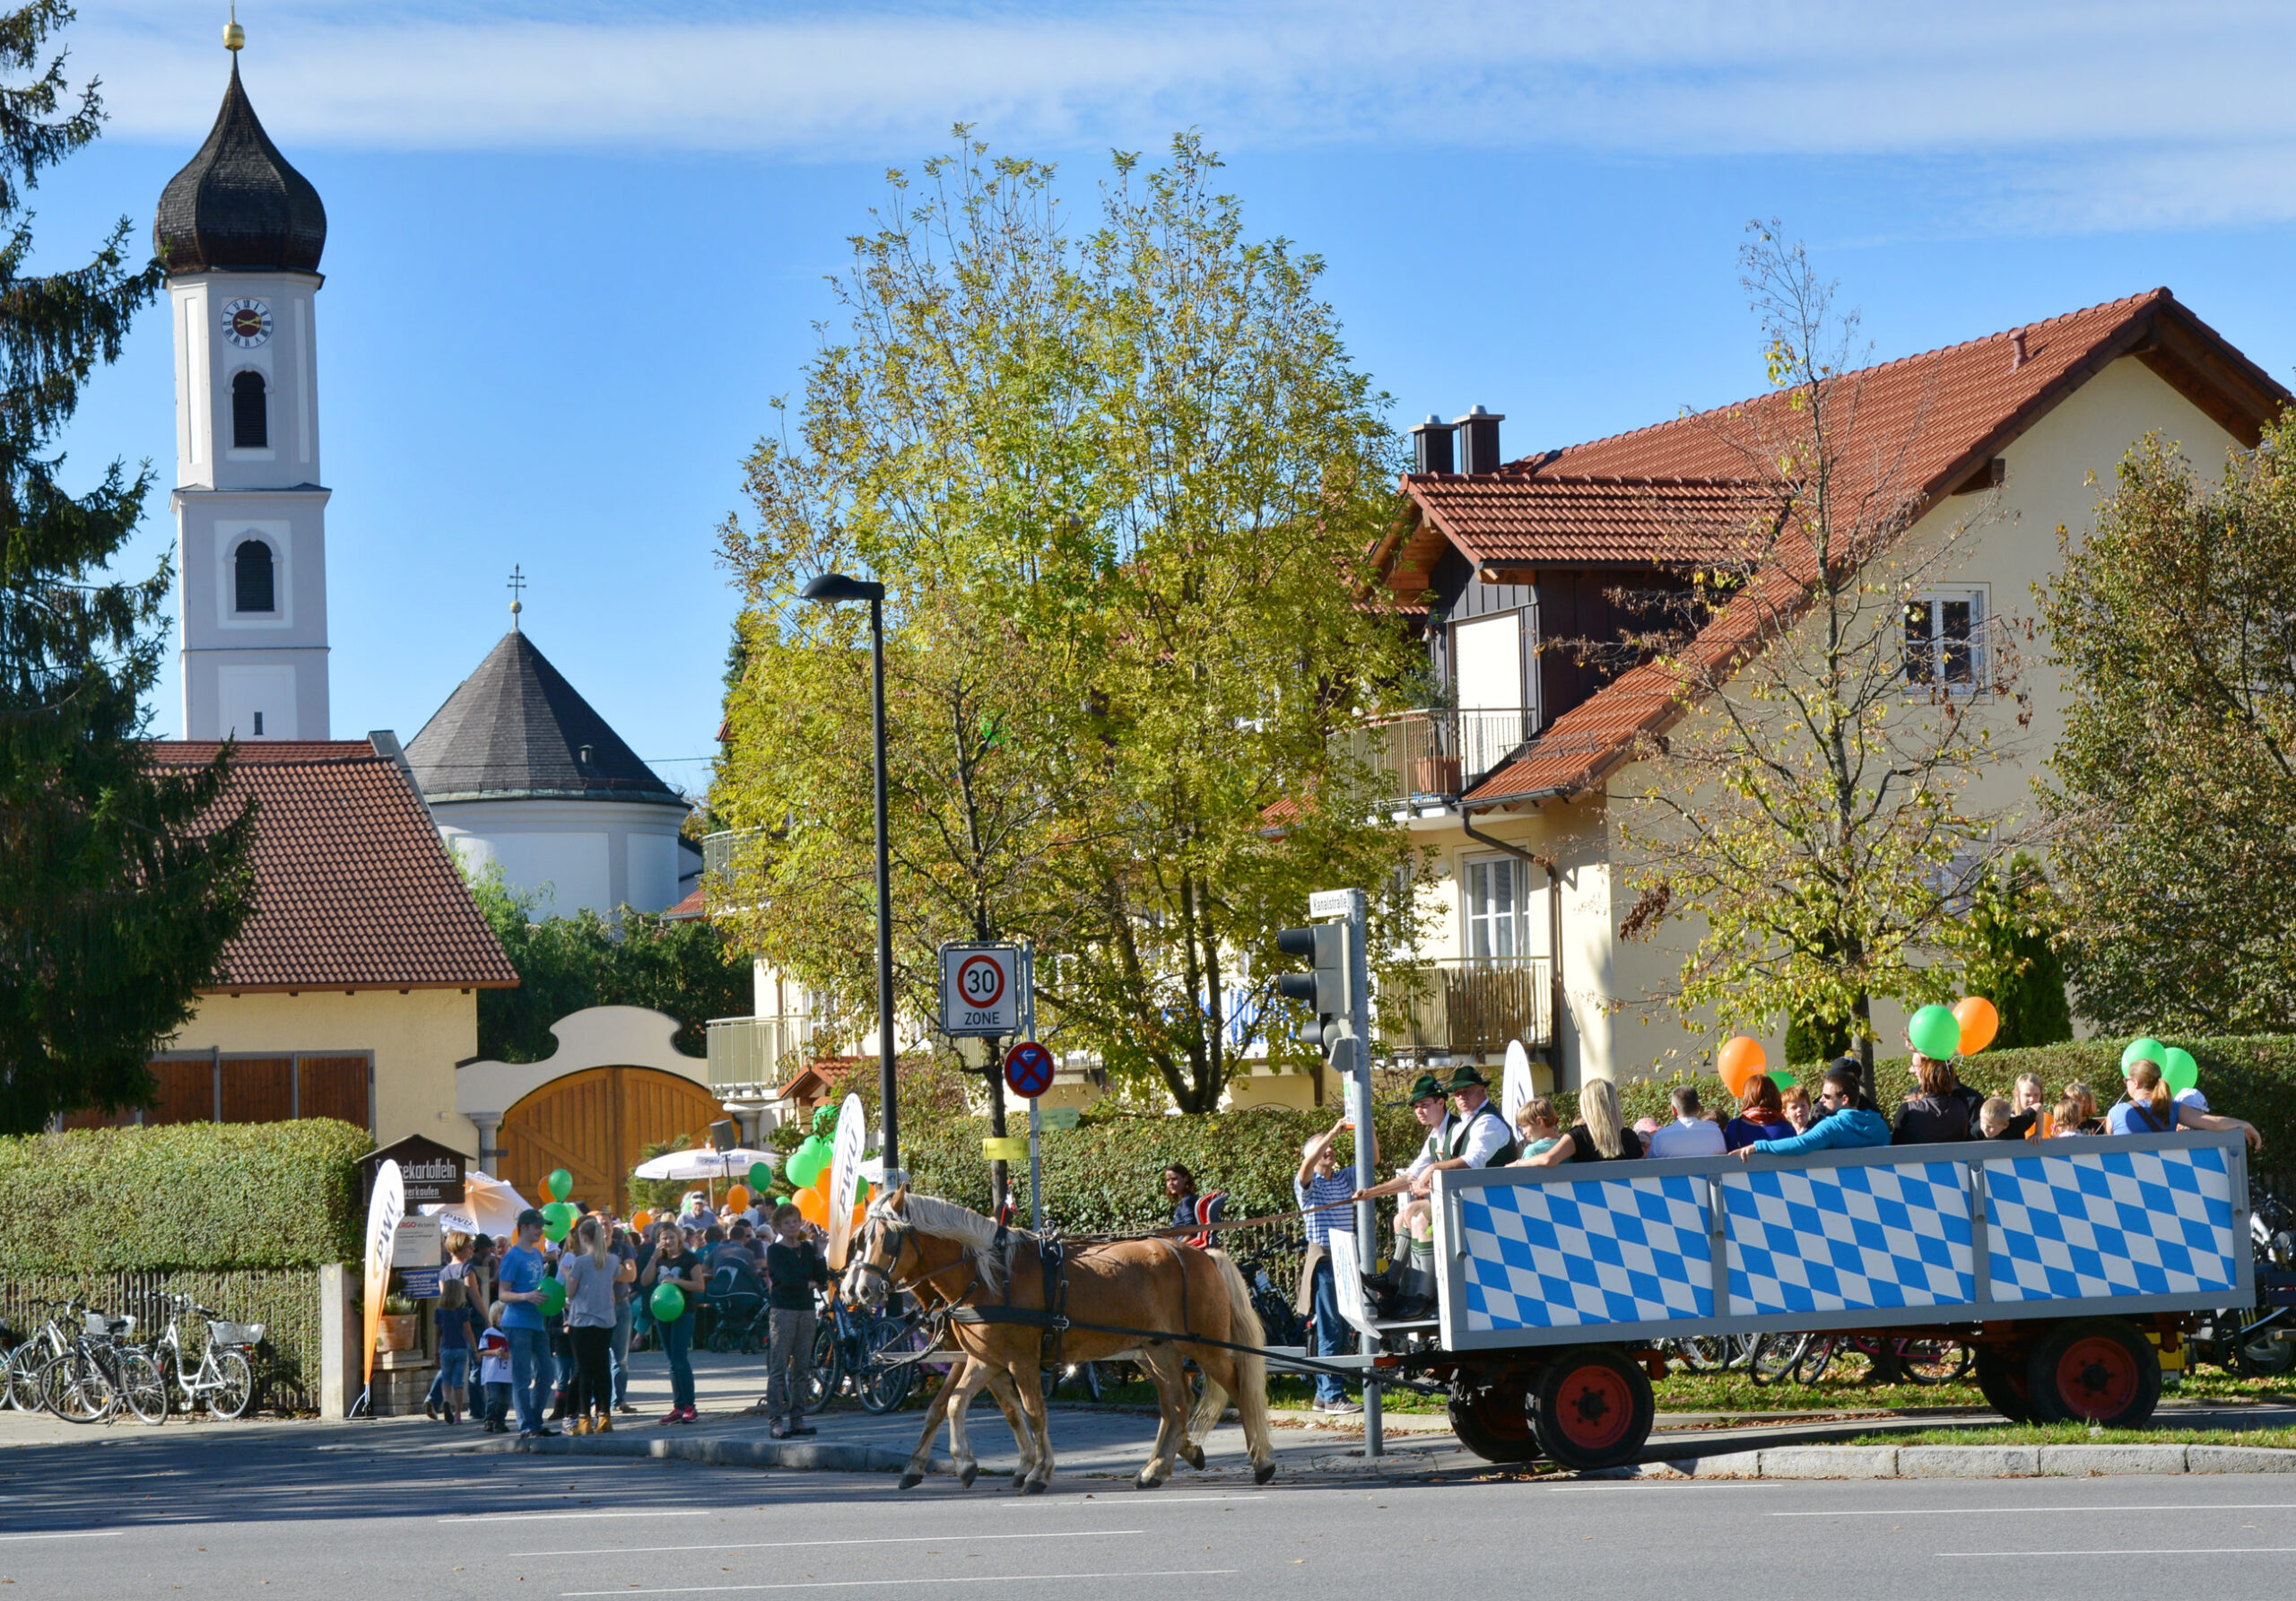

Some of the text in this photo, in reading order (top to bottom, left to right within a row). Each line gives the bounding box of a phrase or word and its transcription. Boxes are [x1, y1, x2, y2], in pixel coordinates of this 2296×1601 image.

[1313, 893, 1347, 912] Kanalstraße
[968, 970, 994, 994] 30
[964, 1012, 1000, 1025] ZONE
